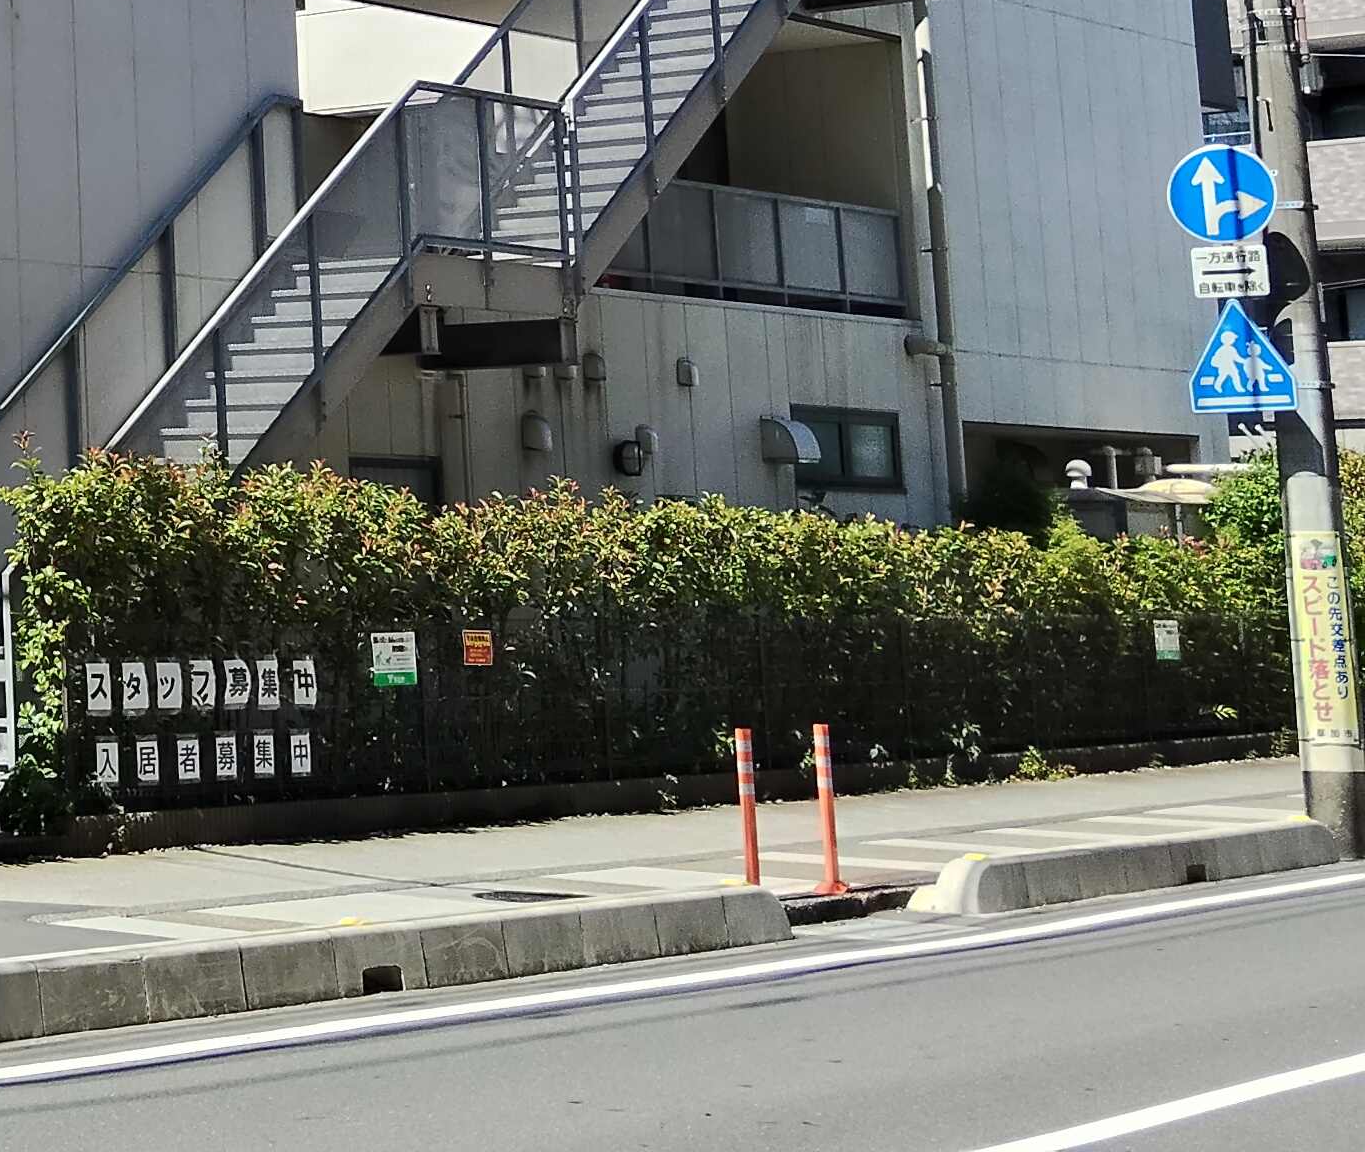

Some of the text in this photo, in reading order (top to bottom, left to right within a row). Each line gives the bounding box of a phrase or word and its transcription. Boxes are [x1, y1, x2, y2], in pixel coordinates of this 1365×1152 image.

[1195, 250, 1261, 264] 一方通行路
[1198, 280, 1265, 295] 自転車を除く
[1302, 576, 1334, 722] スピード落とせ
[1326, 576, 1349, 700] この先交差点あり
[90, 667, 315, 704] スタッフ募集中
[98, 739, 308, 778] 入居者募集中
